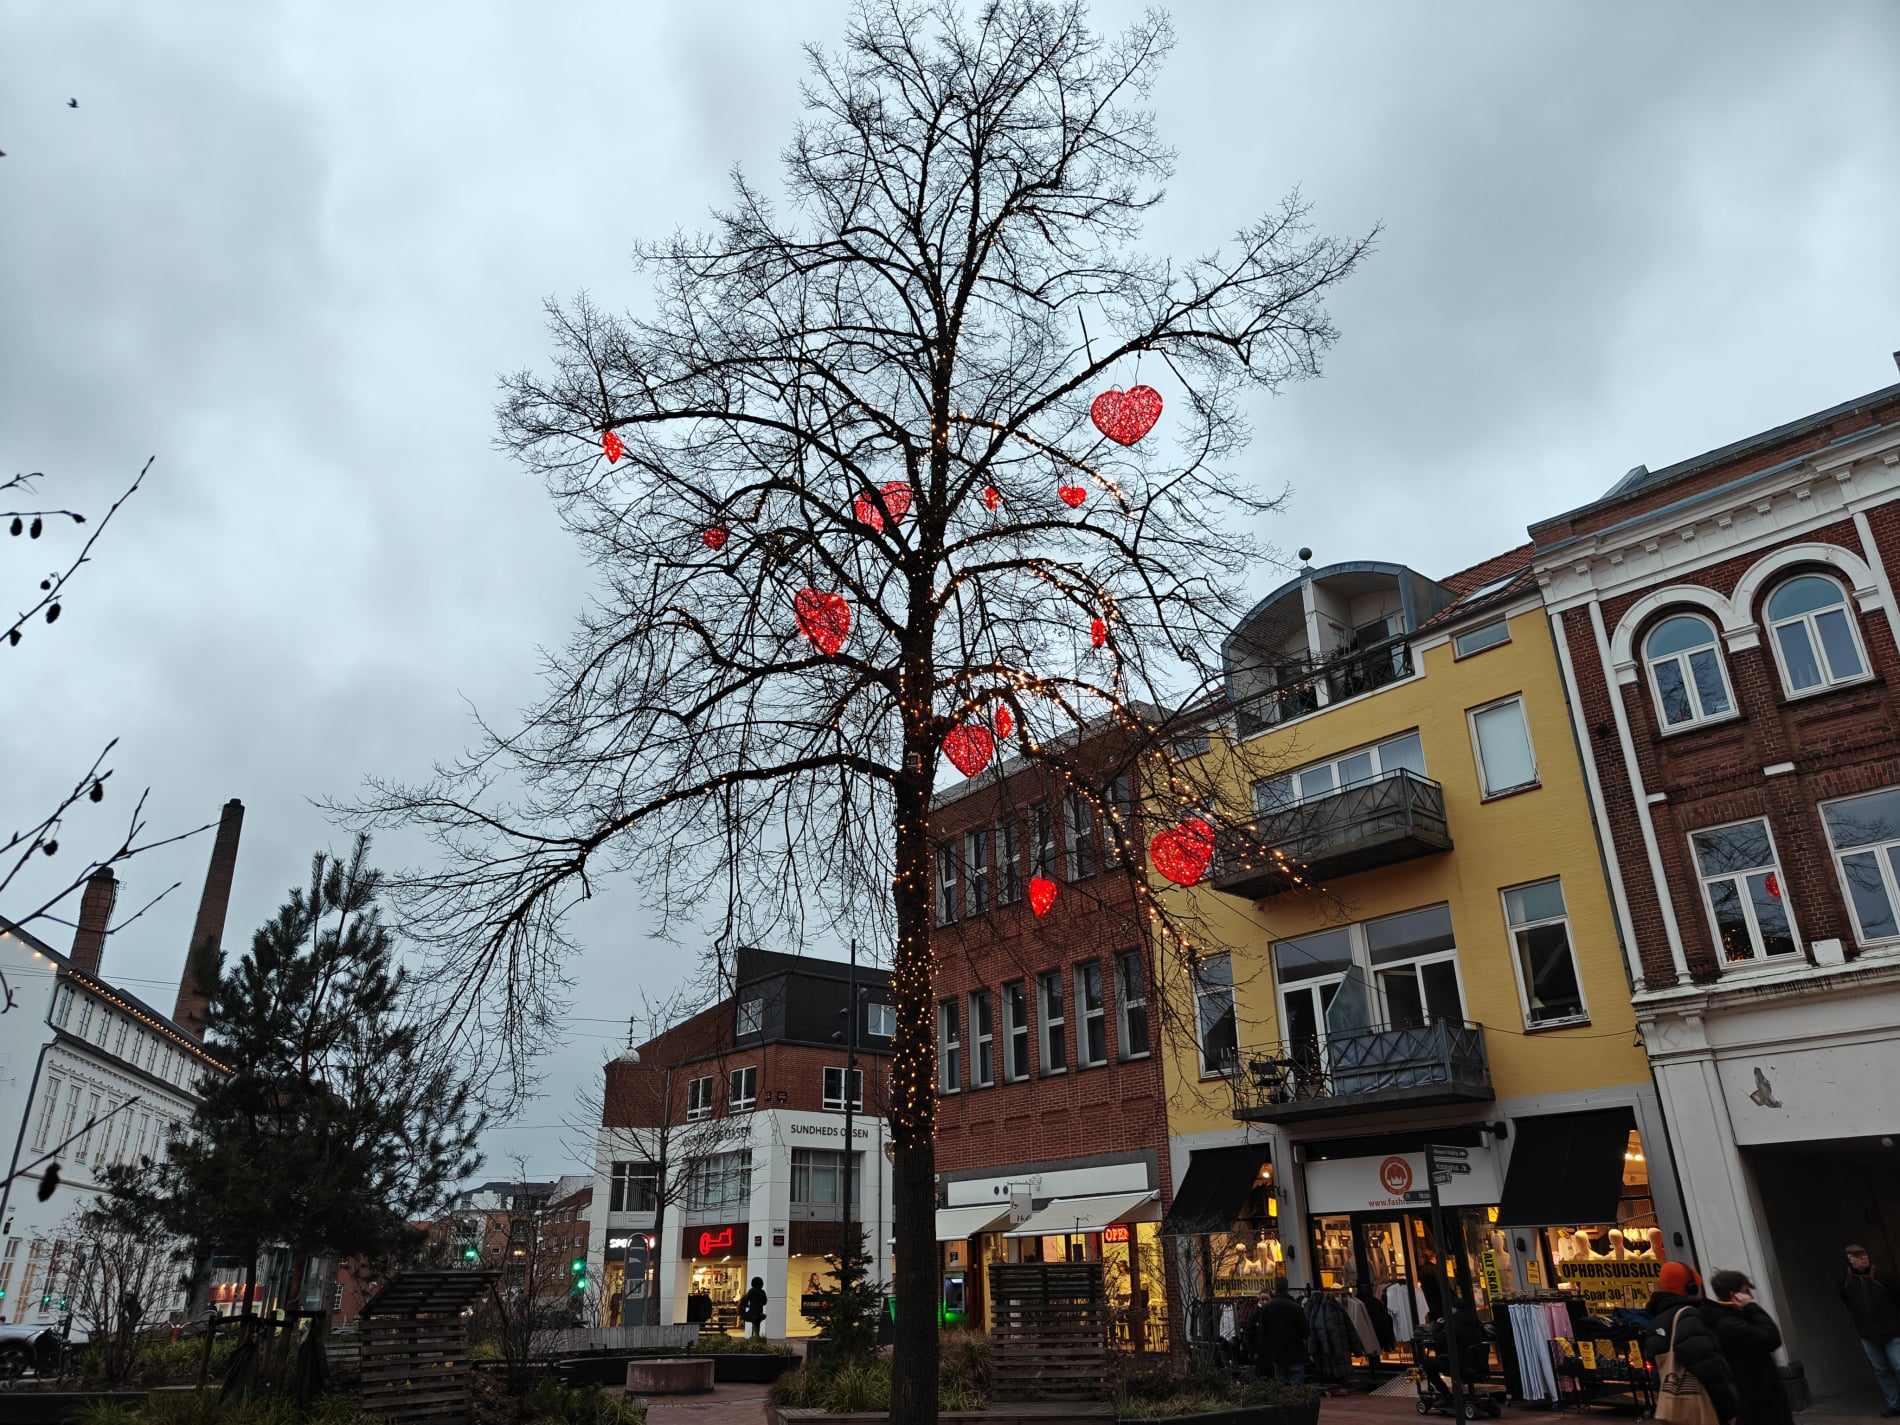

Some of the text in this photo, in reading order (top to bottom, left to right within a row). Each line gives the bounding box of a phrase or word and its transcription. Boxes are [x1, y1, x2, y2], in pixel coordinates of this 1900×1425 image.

[791, 1124, 869, 1138] SUNDHEDS OSEN
[1583, 1288, 1647, 1301] Spar 30-0%
